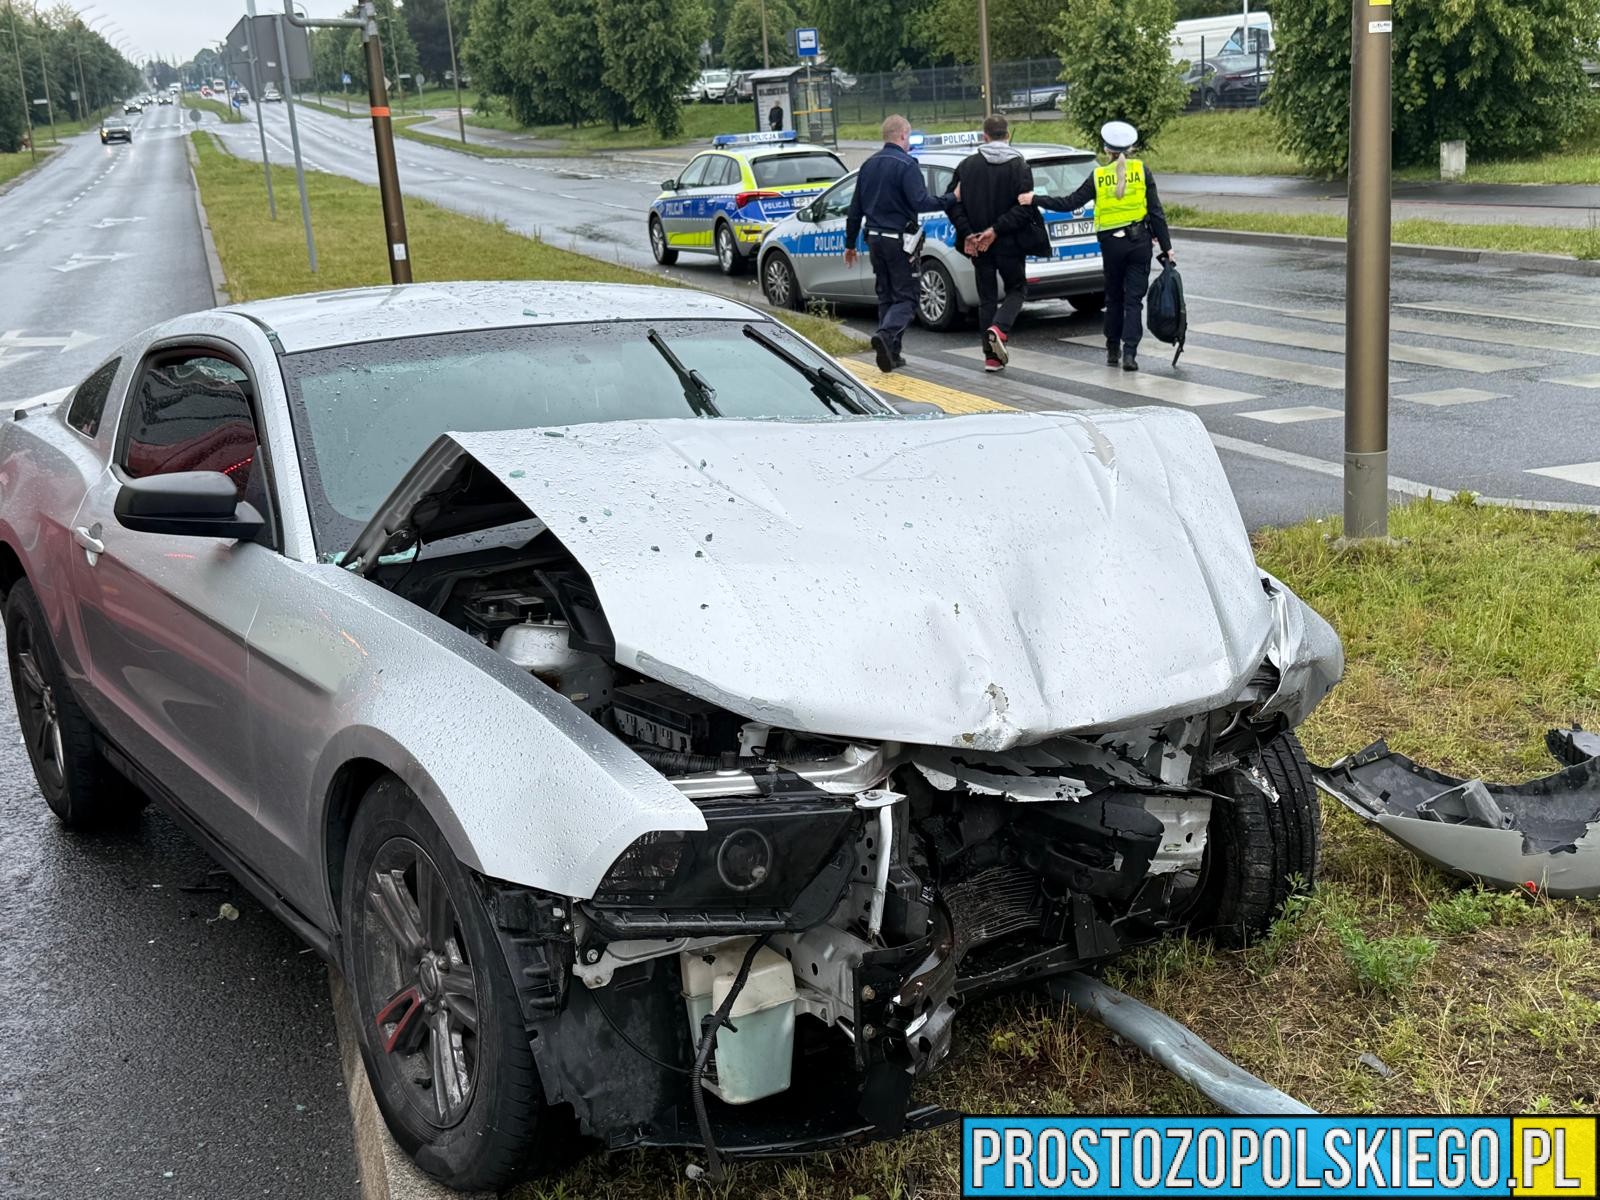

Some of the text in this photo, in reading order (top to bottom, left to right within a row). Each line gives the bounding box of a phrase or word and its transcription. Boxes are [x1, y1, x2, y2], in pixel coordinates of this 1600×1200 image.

[943, 133, 976, 144] POLICJA
[1098, 171, 1141, 188] POLJA
[665, 202, 684, 216] POLICJA
[763, 200, 791, 210] POLICJA
[814, 235, 845, 251] POLICJA
